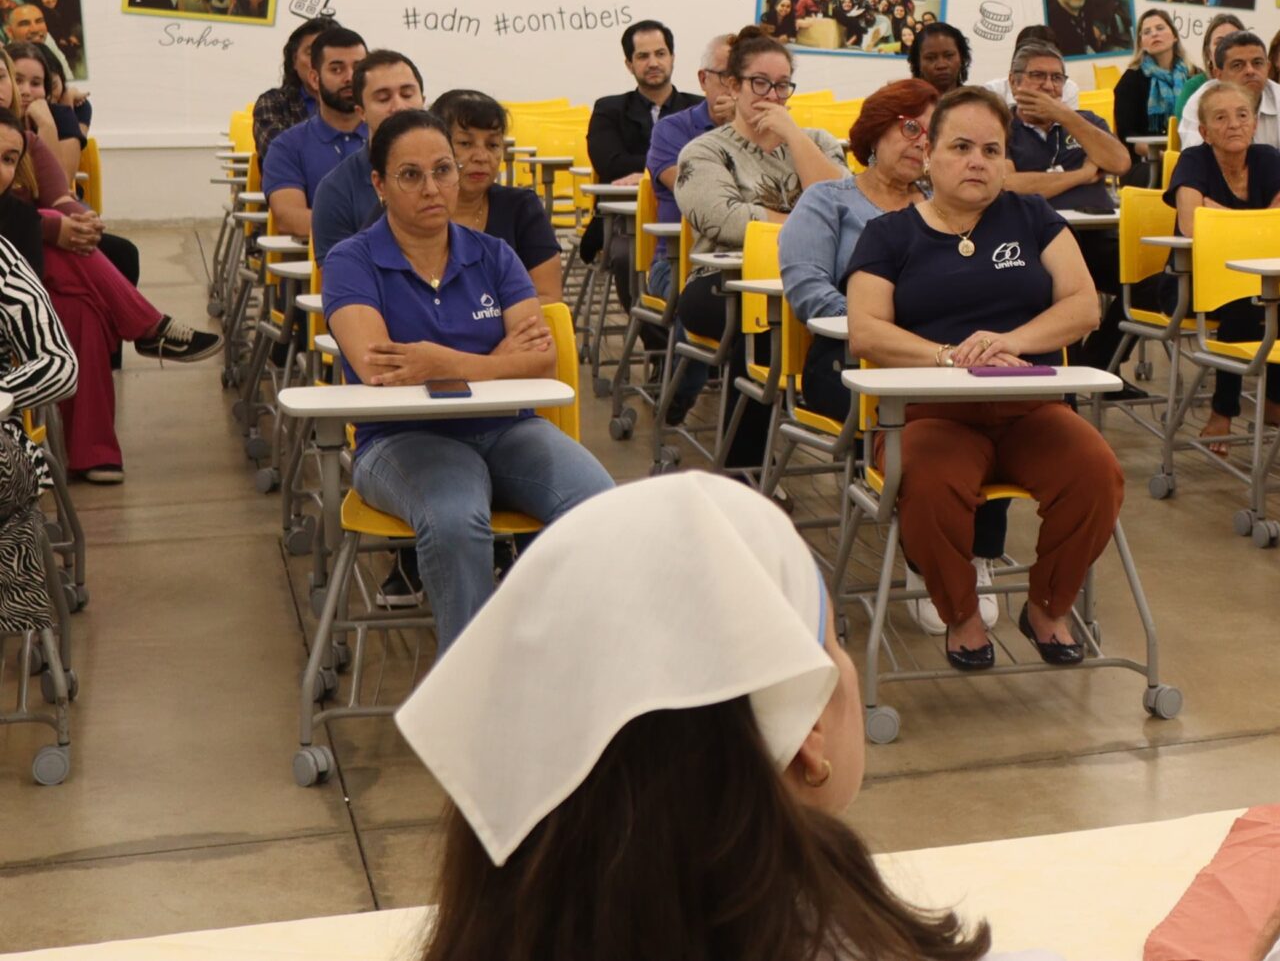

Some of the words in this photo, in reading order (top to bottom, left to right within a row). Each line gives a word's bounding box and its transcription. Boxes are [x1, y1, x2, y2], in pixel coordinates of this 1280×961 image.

[402, 7, 481, 37] #adm
[493, 5, 634, 35] #contabeis
[158, 22, 235, 50] Sonhos
[472, 307, 502, 320] unife
